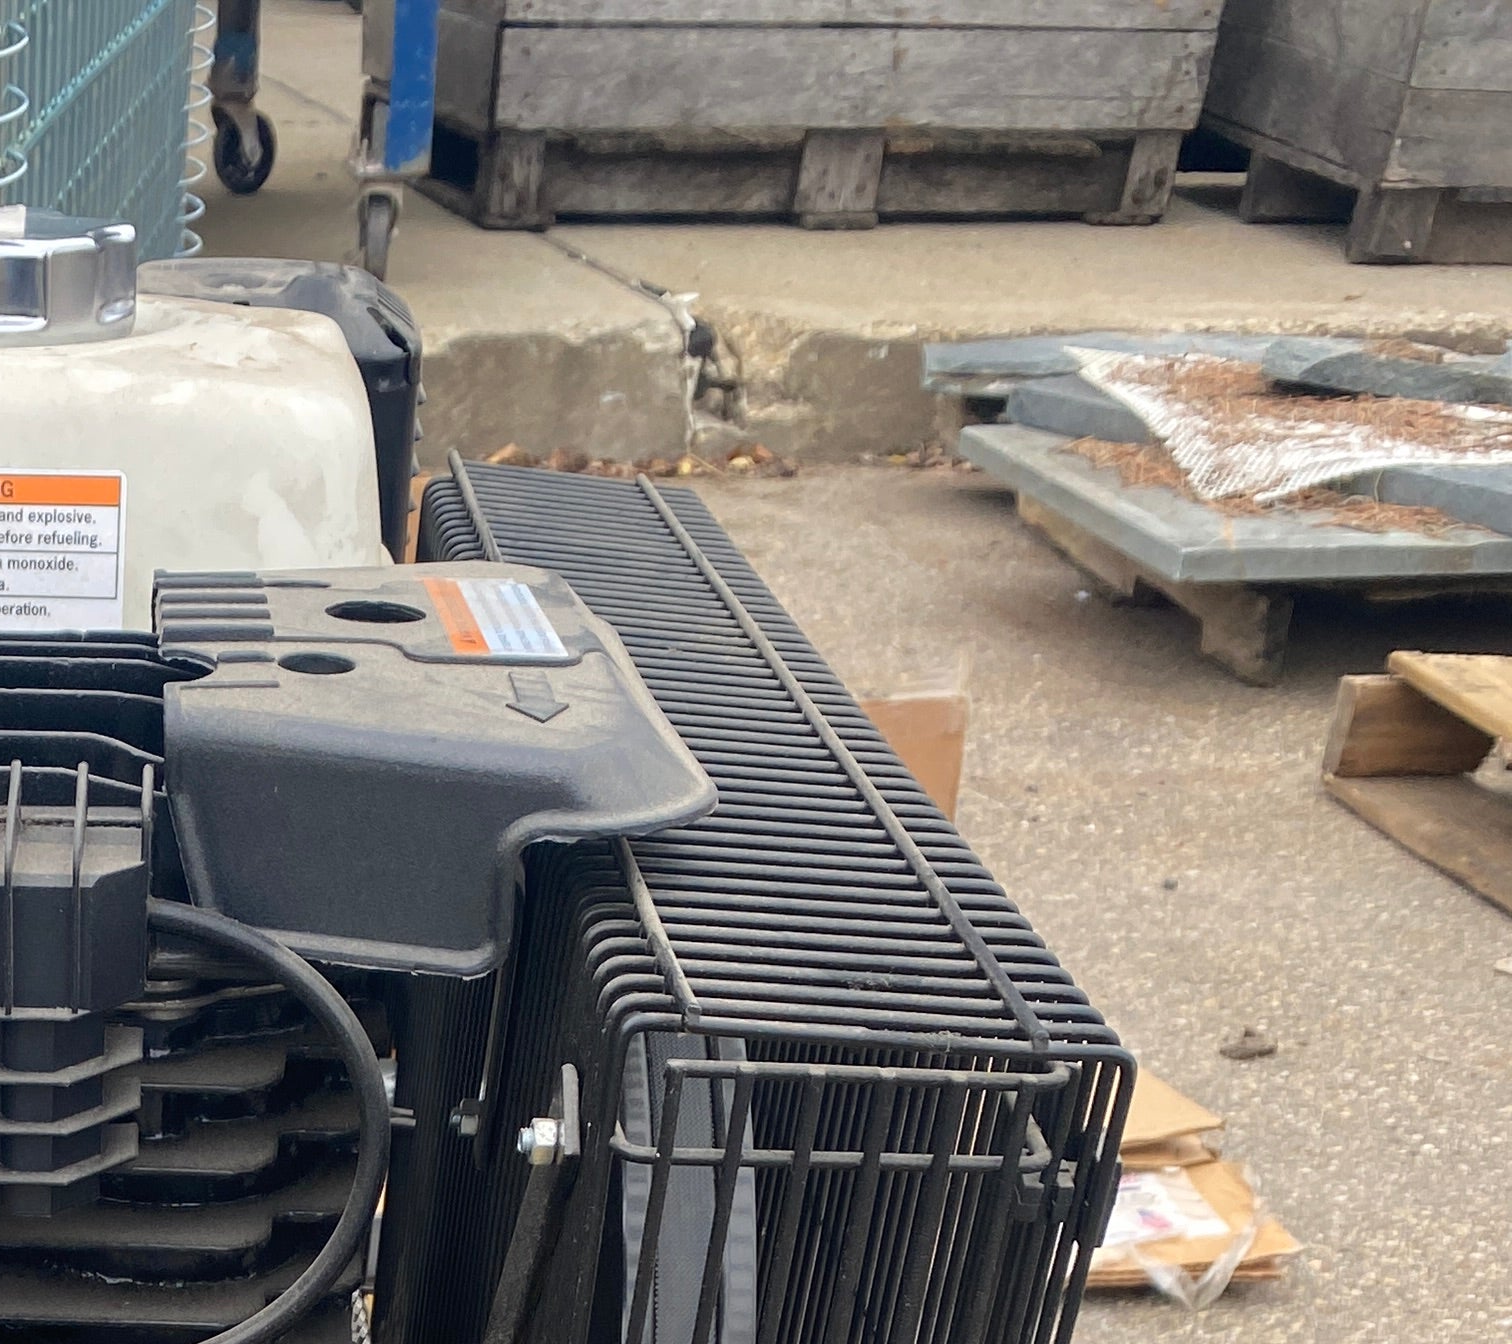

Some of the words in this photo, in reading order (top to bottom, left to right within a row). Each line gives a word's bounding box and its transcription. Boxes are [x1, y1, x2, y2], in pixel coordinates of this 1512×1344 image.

[28, 509, 97, 526] explosive.
[37, 530, 103, 549] refueling.
[7, 555, 79, 571] monoxide.
